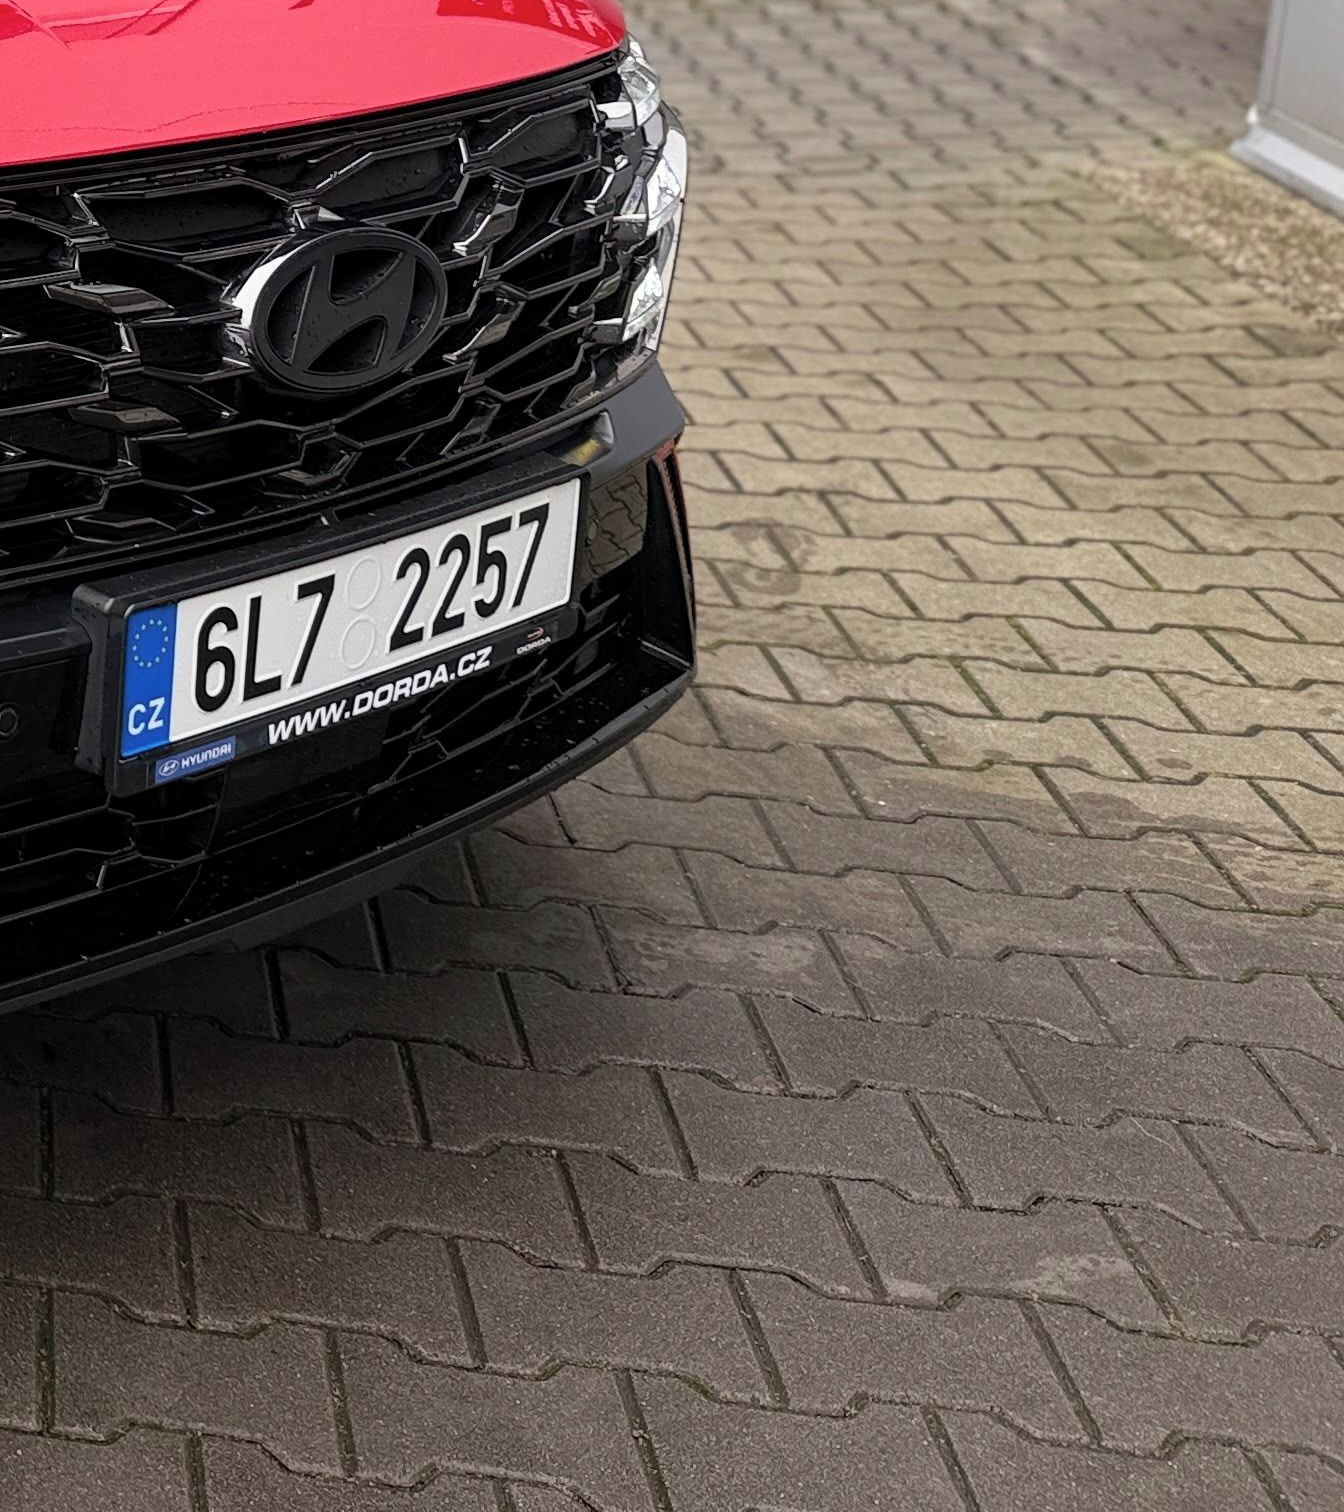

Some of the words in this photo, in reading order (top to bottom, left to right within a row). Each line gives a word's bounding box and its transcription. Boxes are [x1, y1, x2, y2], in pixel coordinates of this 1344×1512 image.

[195, 573, 336, 713] 6L7
[388, 502, 550, 655] 2257
[128, 696, 165, 735] CZ
[267, 645, 493, 745] WWW.DORDA.CZ
[181, 743, 232, 769] HYUNDAI
